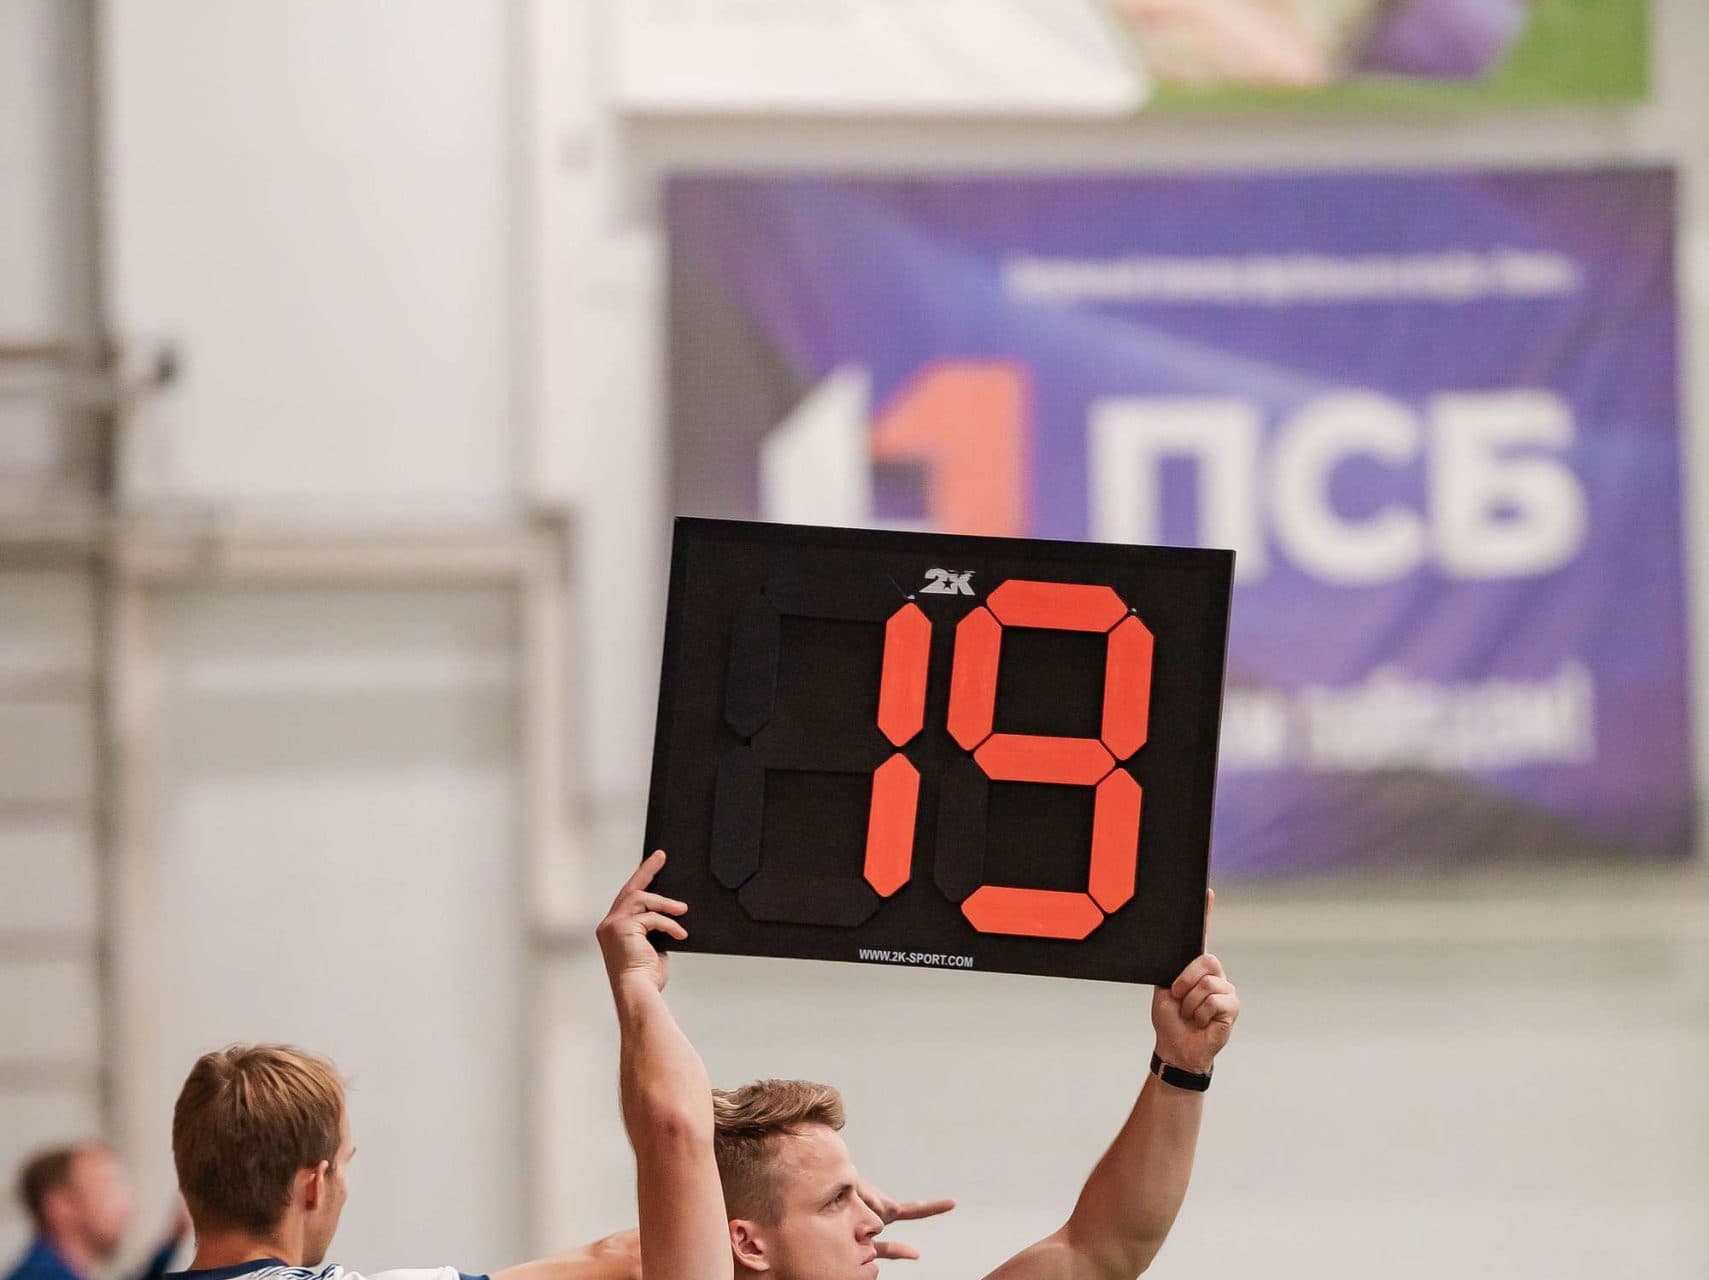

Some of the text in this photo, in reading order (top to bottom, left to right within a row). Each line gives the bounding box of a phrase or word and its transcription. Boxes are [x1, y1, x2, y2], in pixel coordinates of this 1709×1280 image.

[1087, 388, 1588, 582] ПСБ
[919, 568, 976, 596] 2K
[863, 578, 1155, 941] 19
[859, 948, 974, 968] WWW.2K-SPORT.COM
